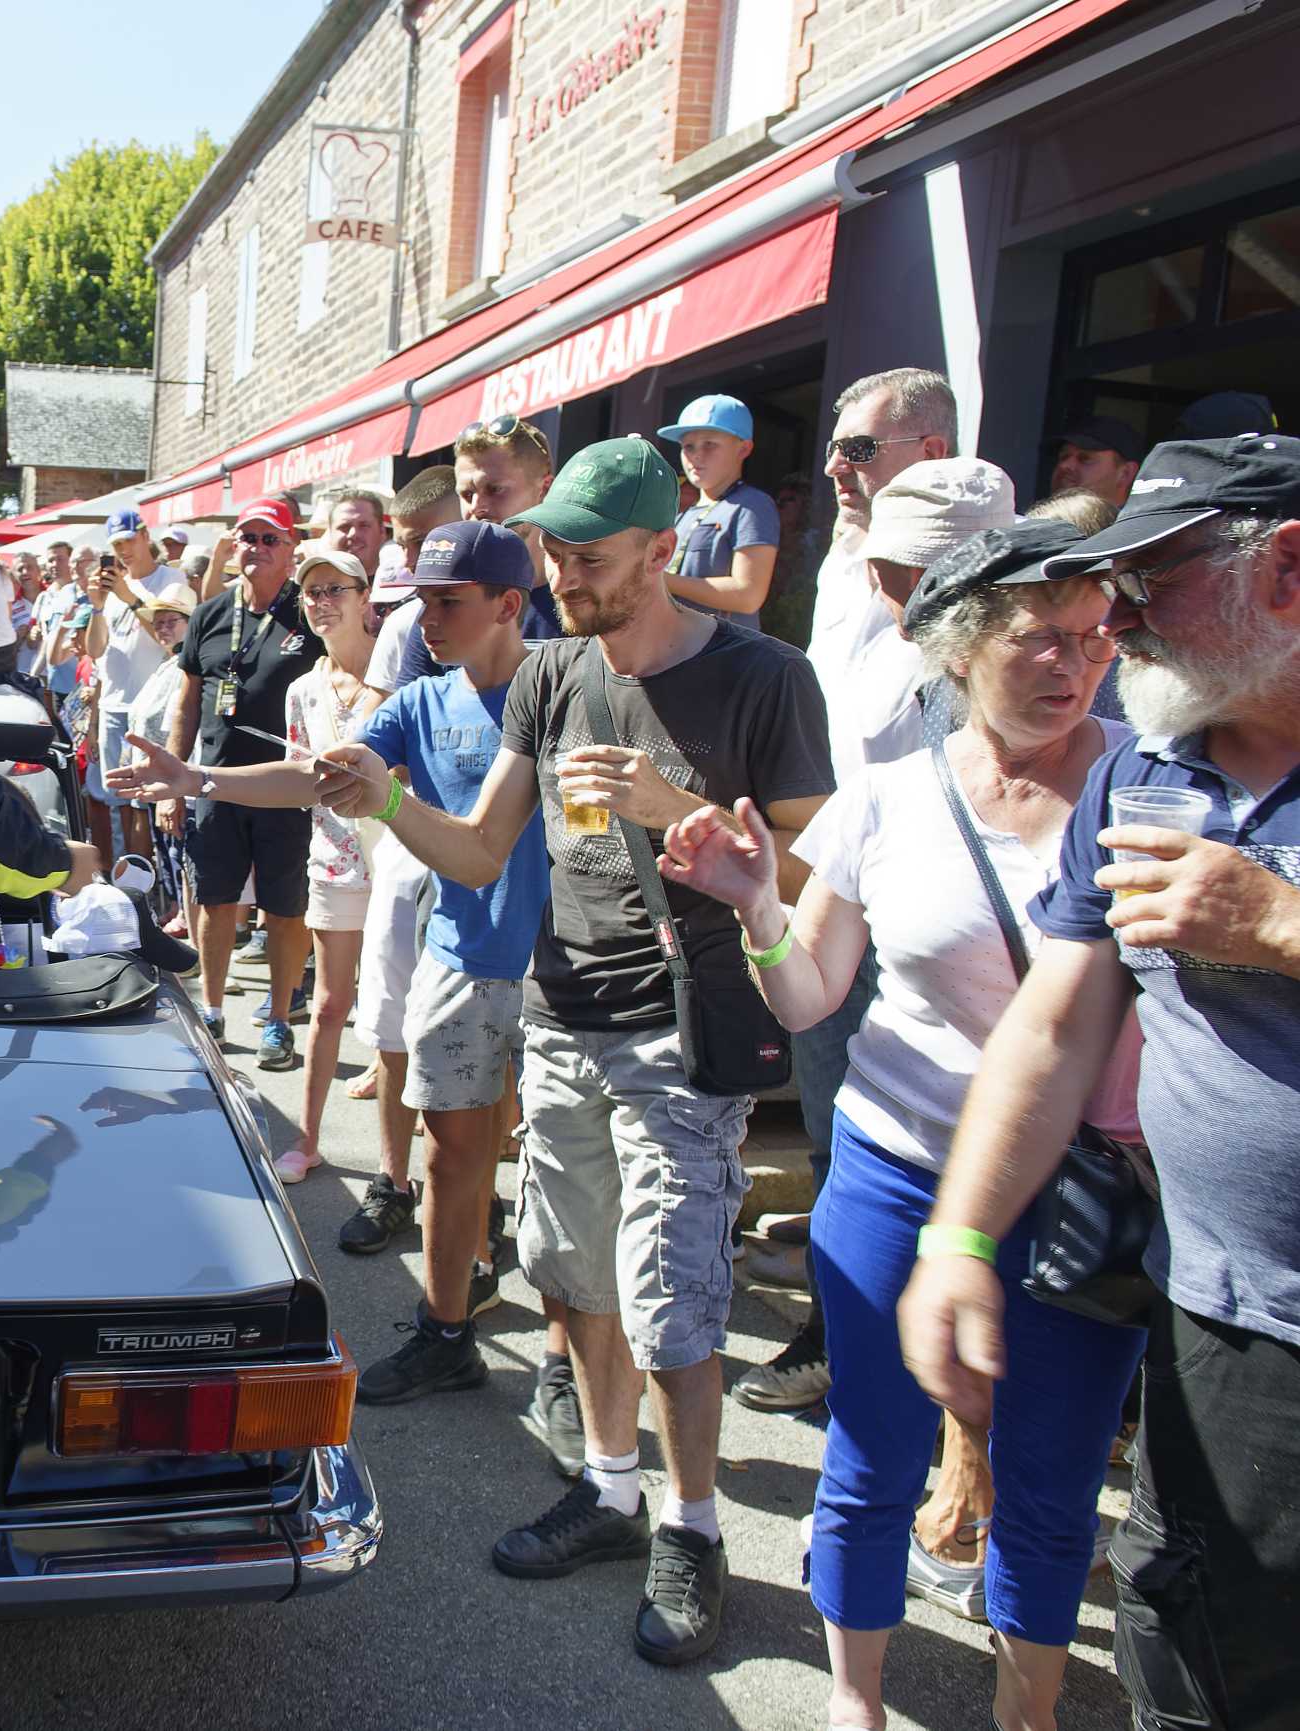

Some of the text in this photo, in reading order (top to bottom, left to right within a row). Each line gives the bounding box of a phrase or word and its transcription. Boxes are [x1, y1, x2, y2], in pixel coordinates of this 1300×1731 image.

[318, 219, 384, 241] CAFE
[478, 286, 684, 425] RESTAURANT
[455, 752, 487, 769] SINCE
[104, 1333, 230, 1350] TRIUMPH
